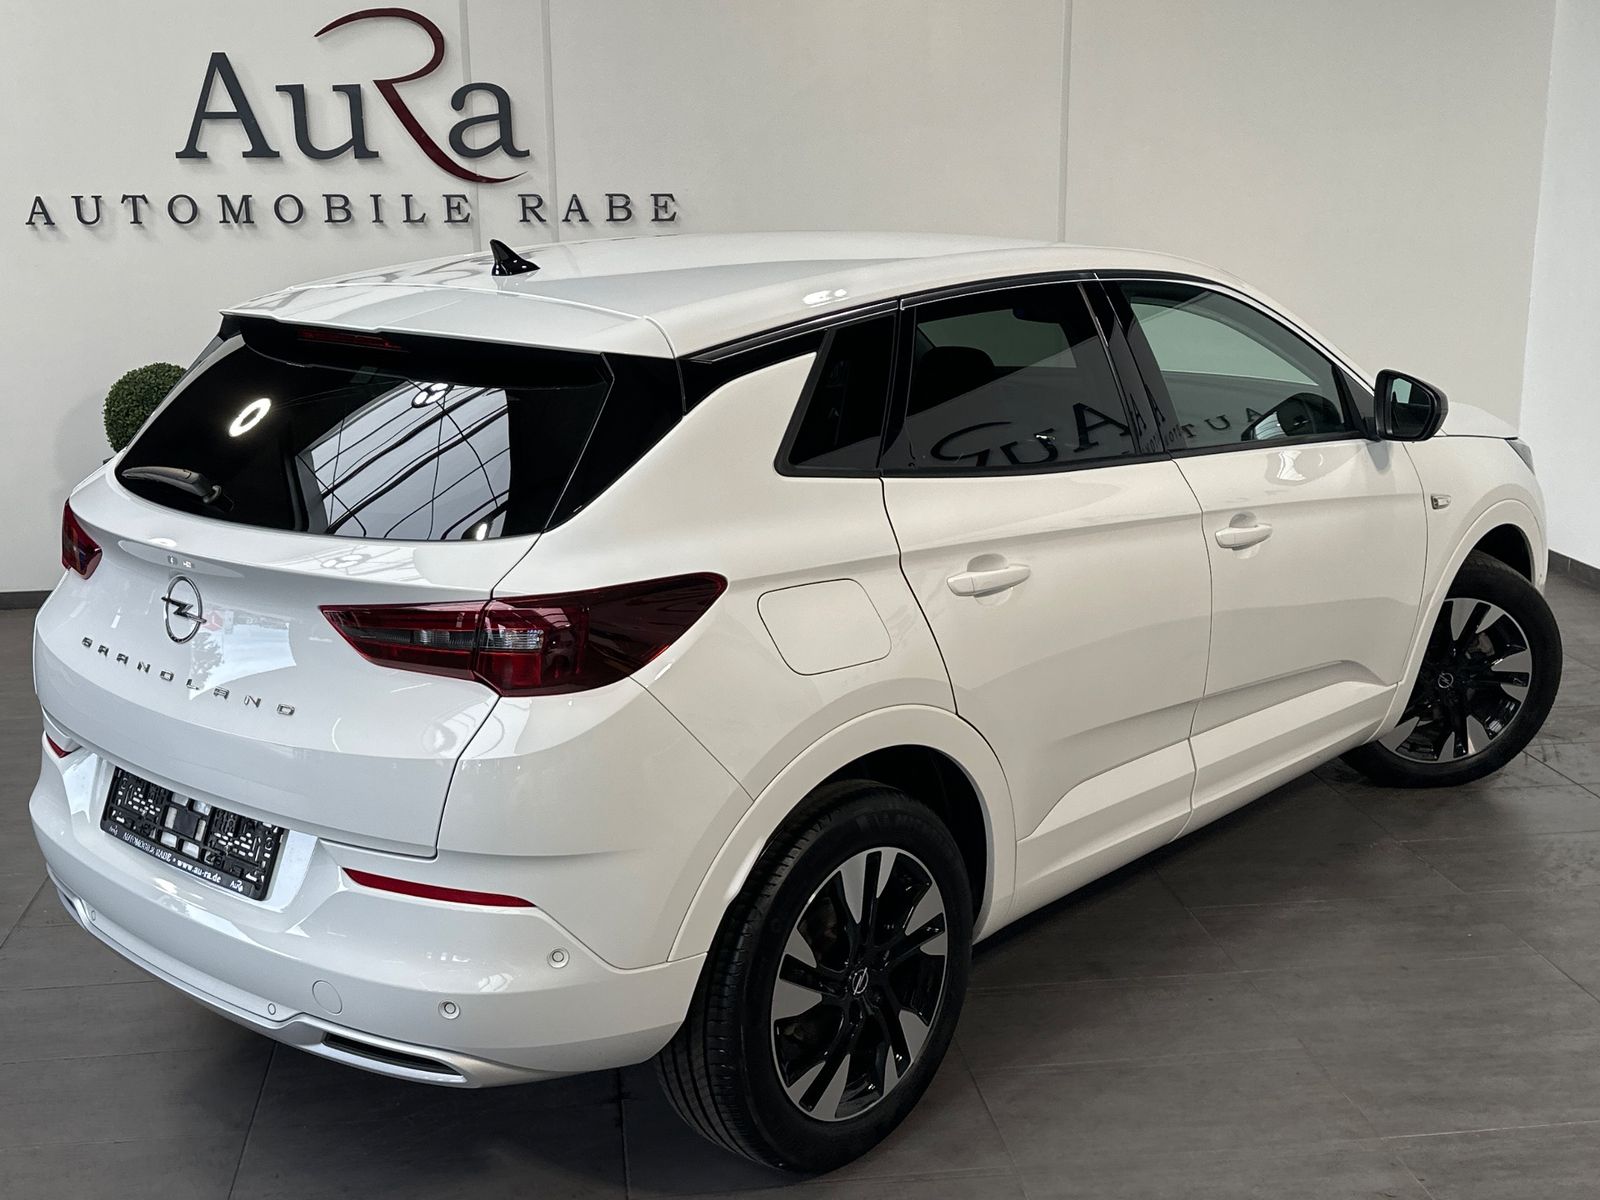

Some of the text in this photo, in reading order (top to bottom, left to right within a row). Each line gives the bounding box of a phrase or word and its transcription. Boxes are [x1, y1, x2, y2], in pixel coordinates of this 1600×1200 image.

[26, 192, 678, 227] AUTOMOBILE RABE
[81, 636, 296, 716] GRANDLAND
[177, 859, 222, 884] www.au-ra.de
